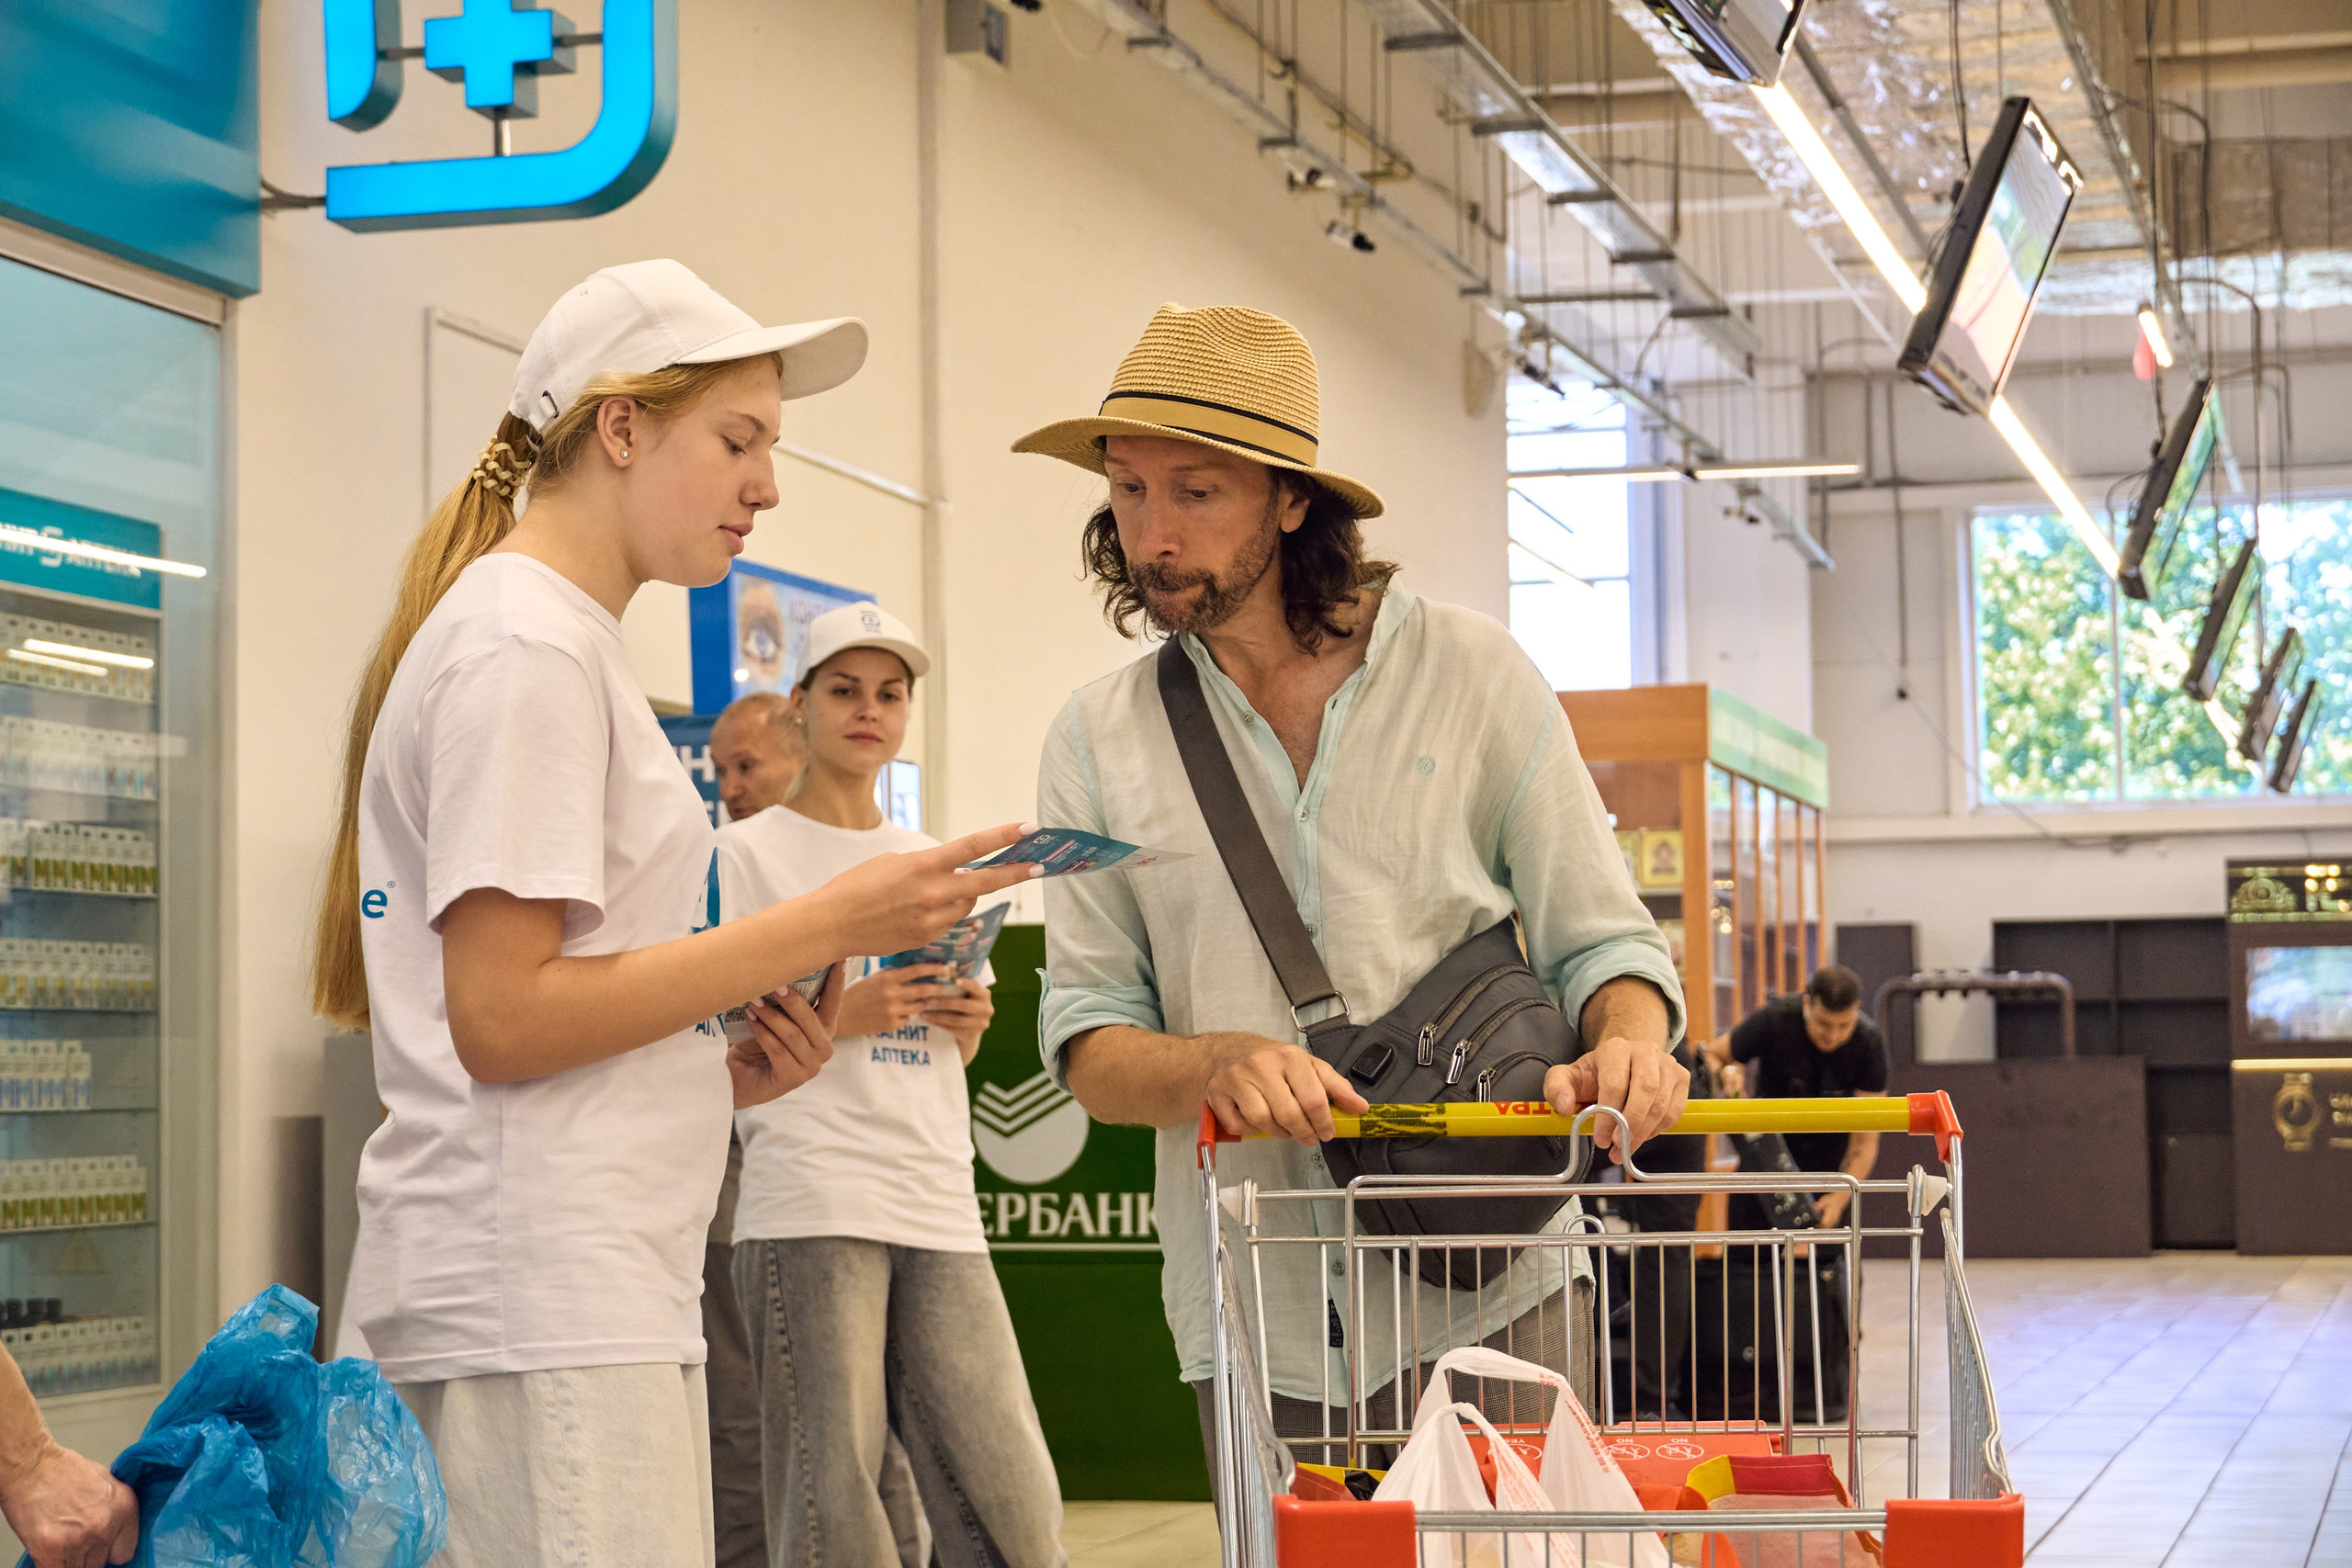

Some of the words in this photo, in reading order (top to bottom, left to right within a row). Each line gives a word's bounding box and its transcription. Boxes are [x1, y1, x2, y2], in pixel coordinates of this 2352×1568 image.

[871, 1046, 931, 1065] АПТЕКА
[1493, 1101, 1556, 1115] ТРА
[976, 1192, 1158, 1237] ЕРБАНК
